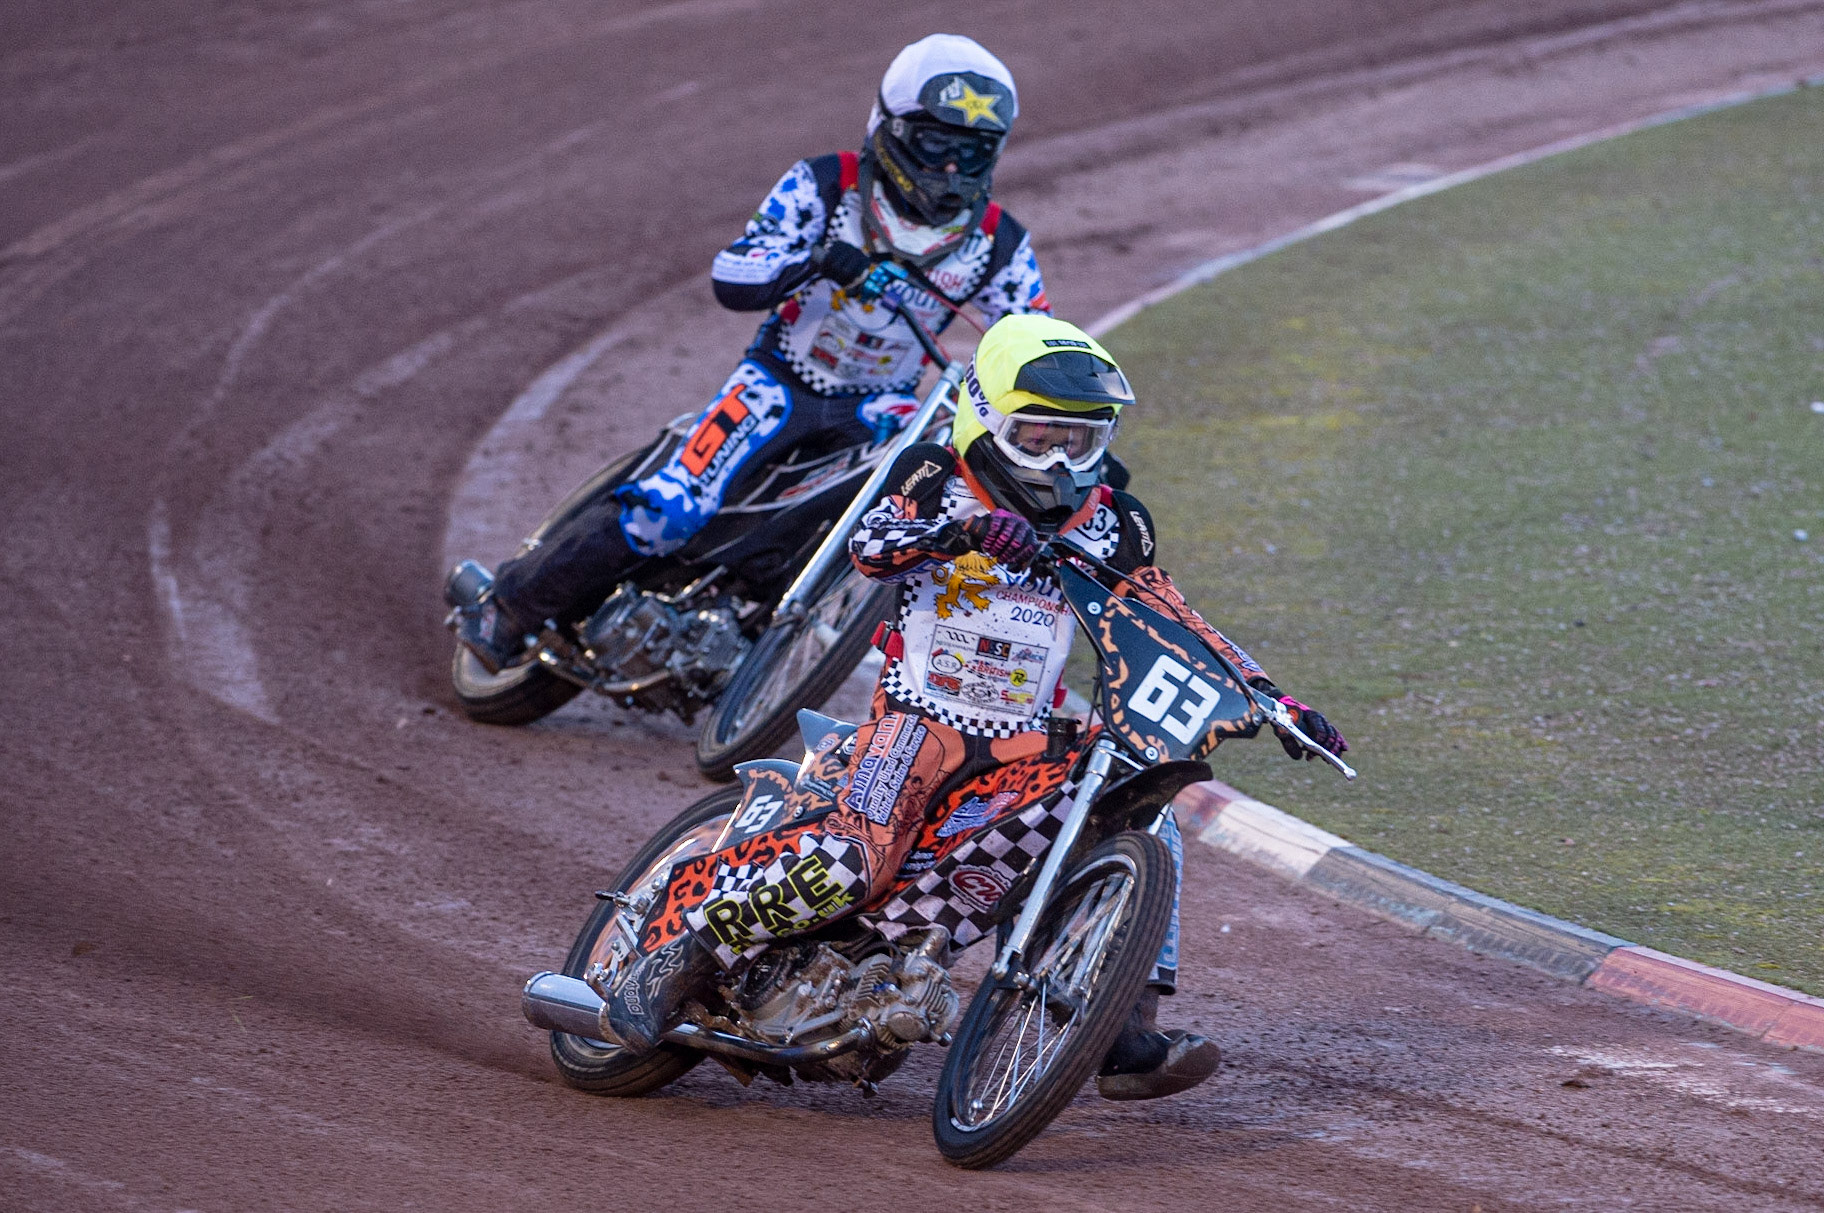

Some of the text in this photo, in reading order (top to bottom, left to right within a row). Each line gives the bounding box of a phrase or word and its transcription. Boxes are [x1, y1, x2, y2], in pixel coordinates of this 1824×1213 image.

[681, 383, 747, 477] GT
[702, 414, 757, 486] TUNING
[1010, 605, 1055, 627] 2020
[1128, 655, 1220, 745] 63
[735, 795, 784, 834] 63
[866, 782, 889, 819] Quality
[879, 758, 898, 783] Used
[875, 789, 898, 825] Vehicle
[889, 764, 909, 792] Sales
[905, 724, 928, 758] Service
[704, 855, 844, 945] RRE
